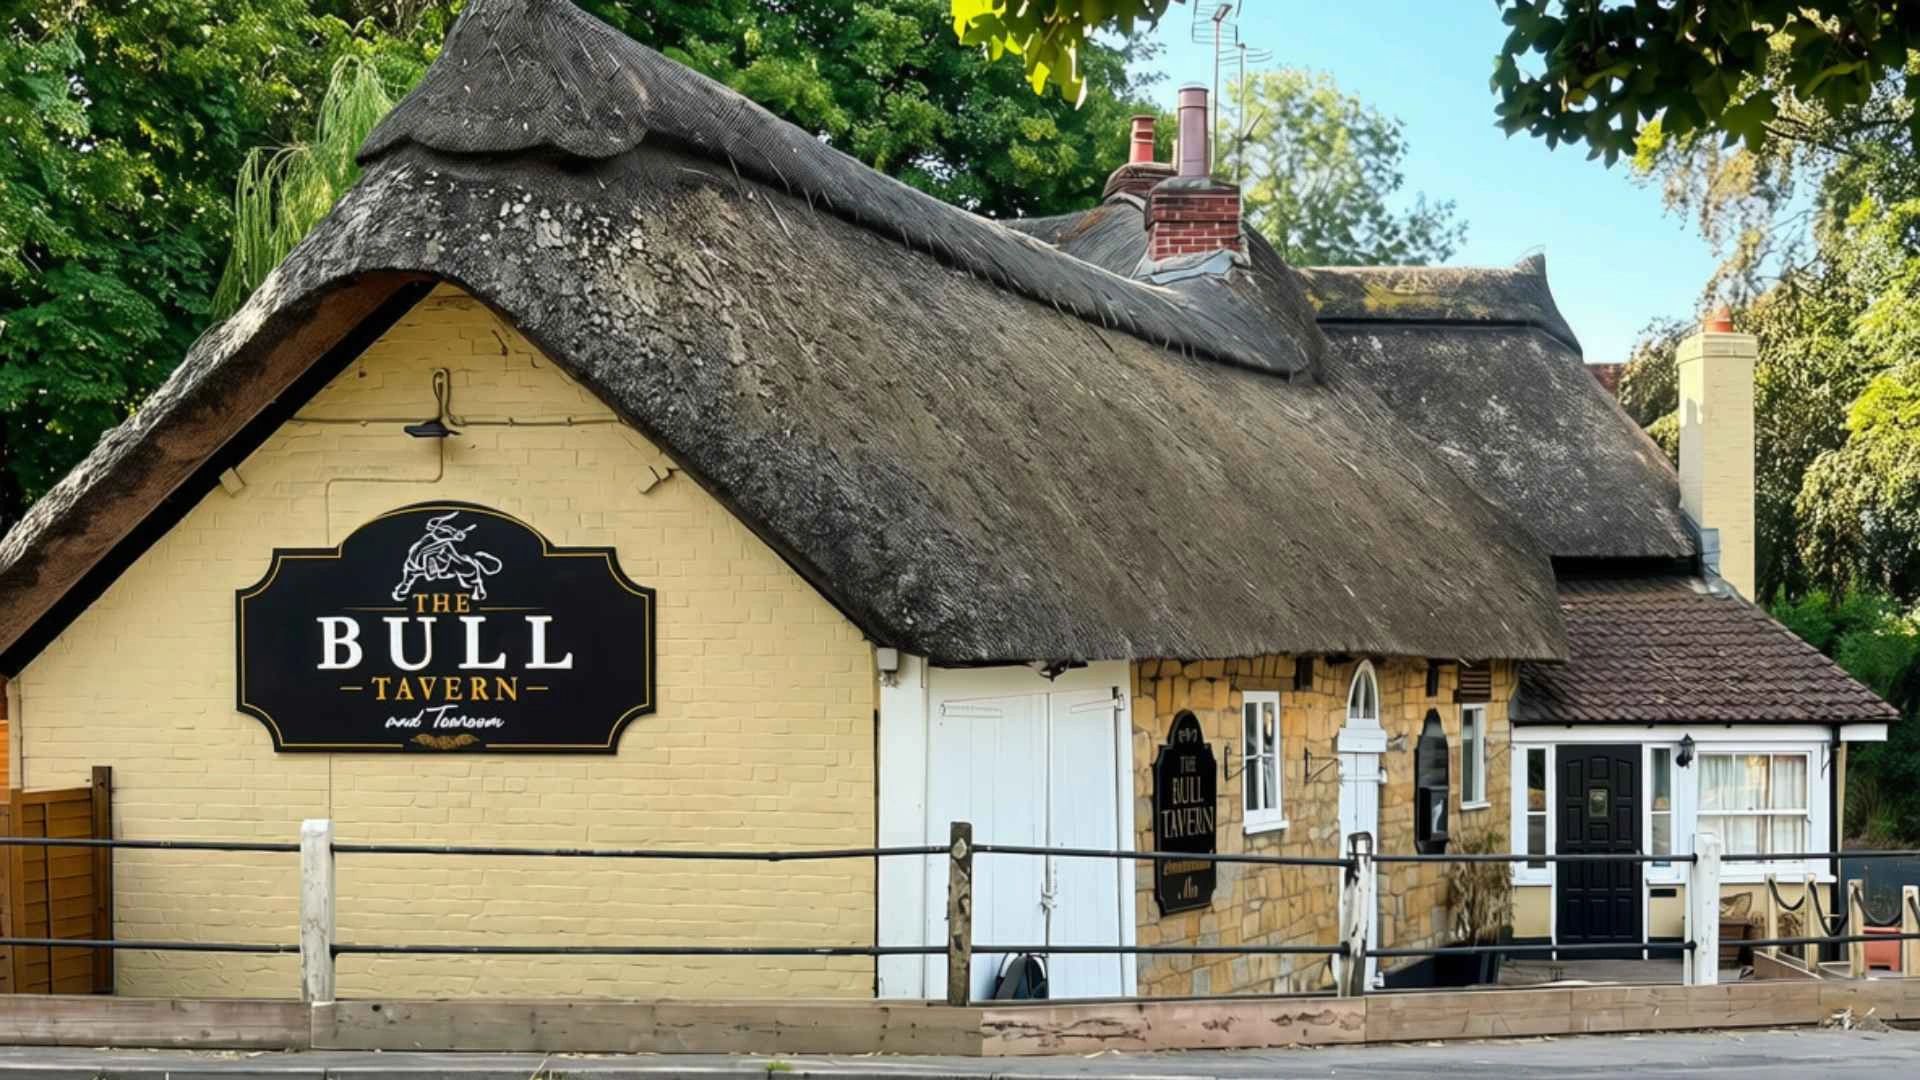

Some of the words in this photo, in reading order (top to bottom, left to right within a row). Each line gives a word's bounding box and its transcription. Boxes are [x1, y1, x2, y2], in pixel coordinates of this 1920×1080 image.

[413, 593, 470, 612] THE
[316, 616, 573, 671] BULL
[372, 677, 518, 701] TAVERN
[384, 709, 424, 729] and
[1172, 776, 1204, 805] BULL
[1160, 806, 1214, 838] TAVERN
